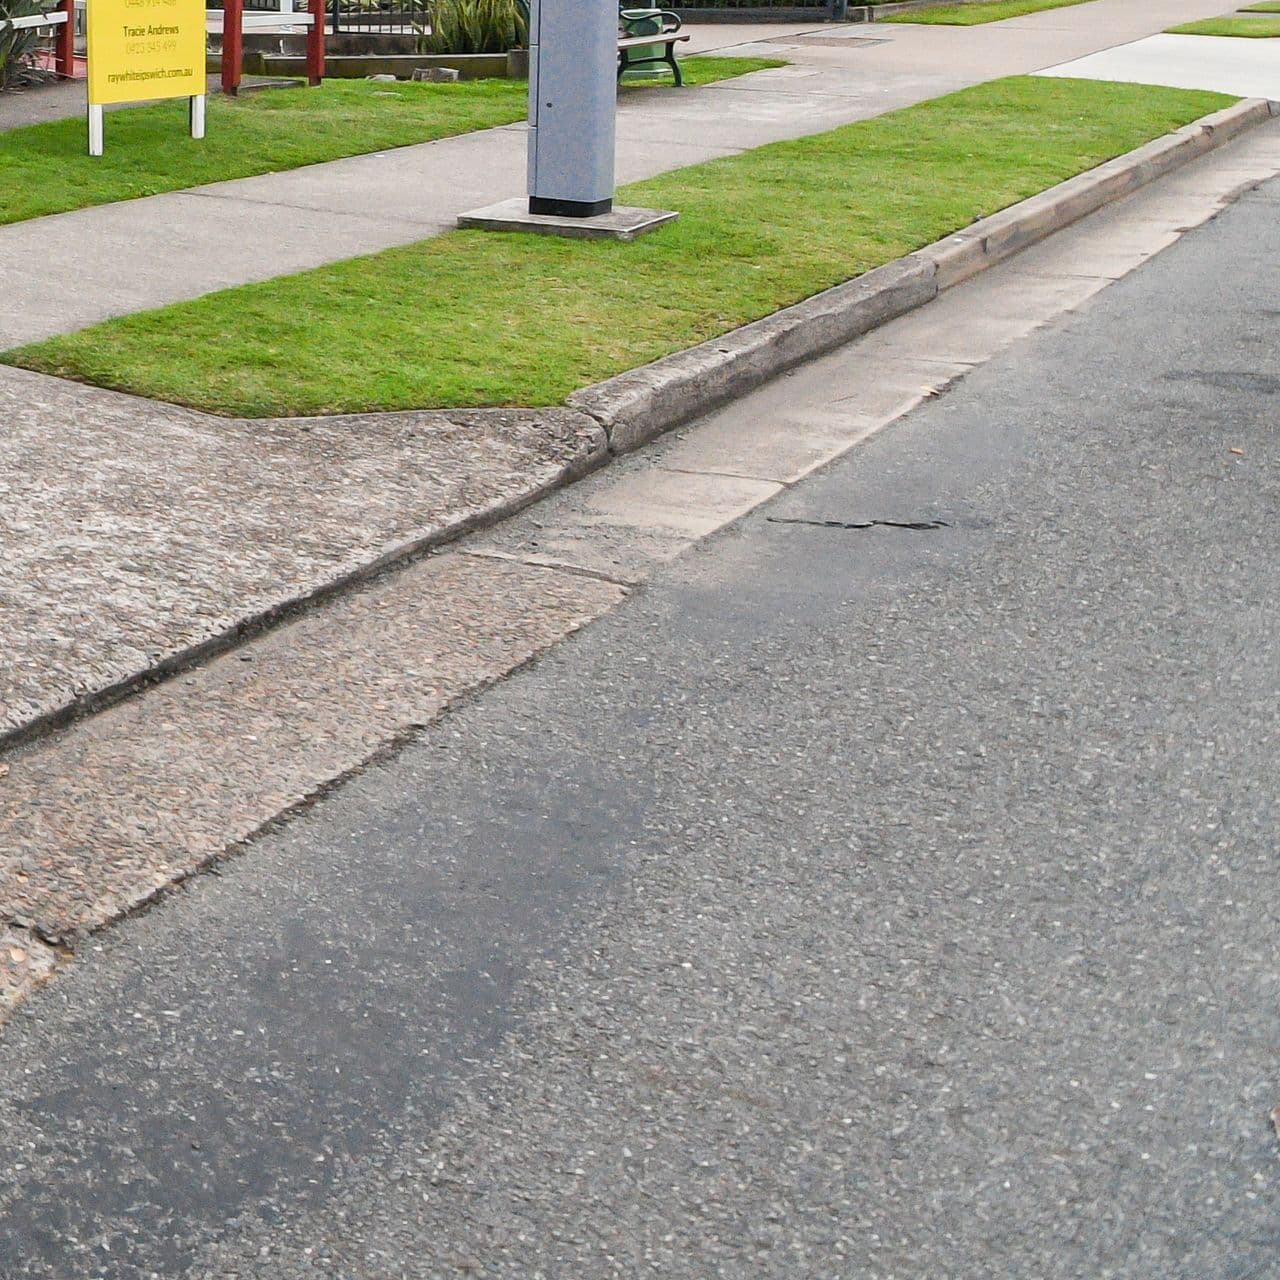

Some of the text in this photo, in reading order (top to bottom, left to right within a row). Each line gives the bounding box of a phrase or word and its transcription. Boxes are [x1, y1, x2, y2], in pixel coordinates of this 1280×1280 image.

[123, 25, 179, 37] Tracie Andrews
[108, 67, 193, 84] raywhiteipswich.com.au
